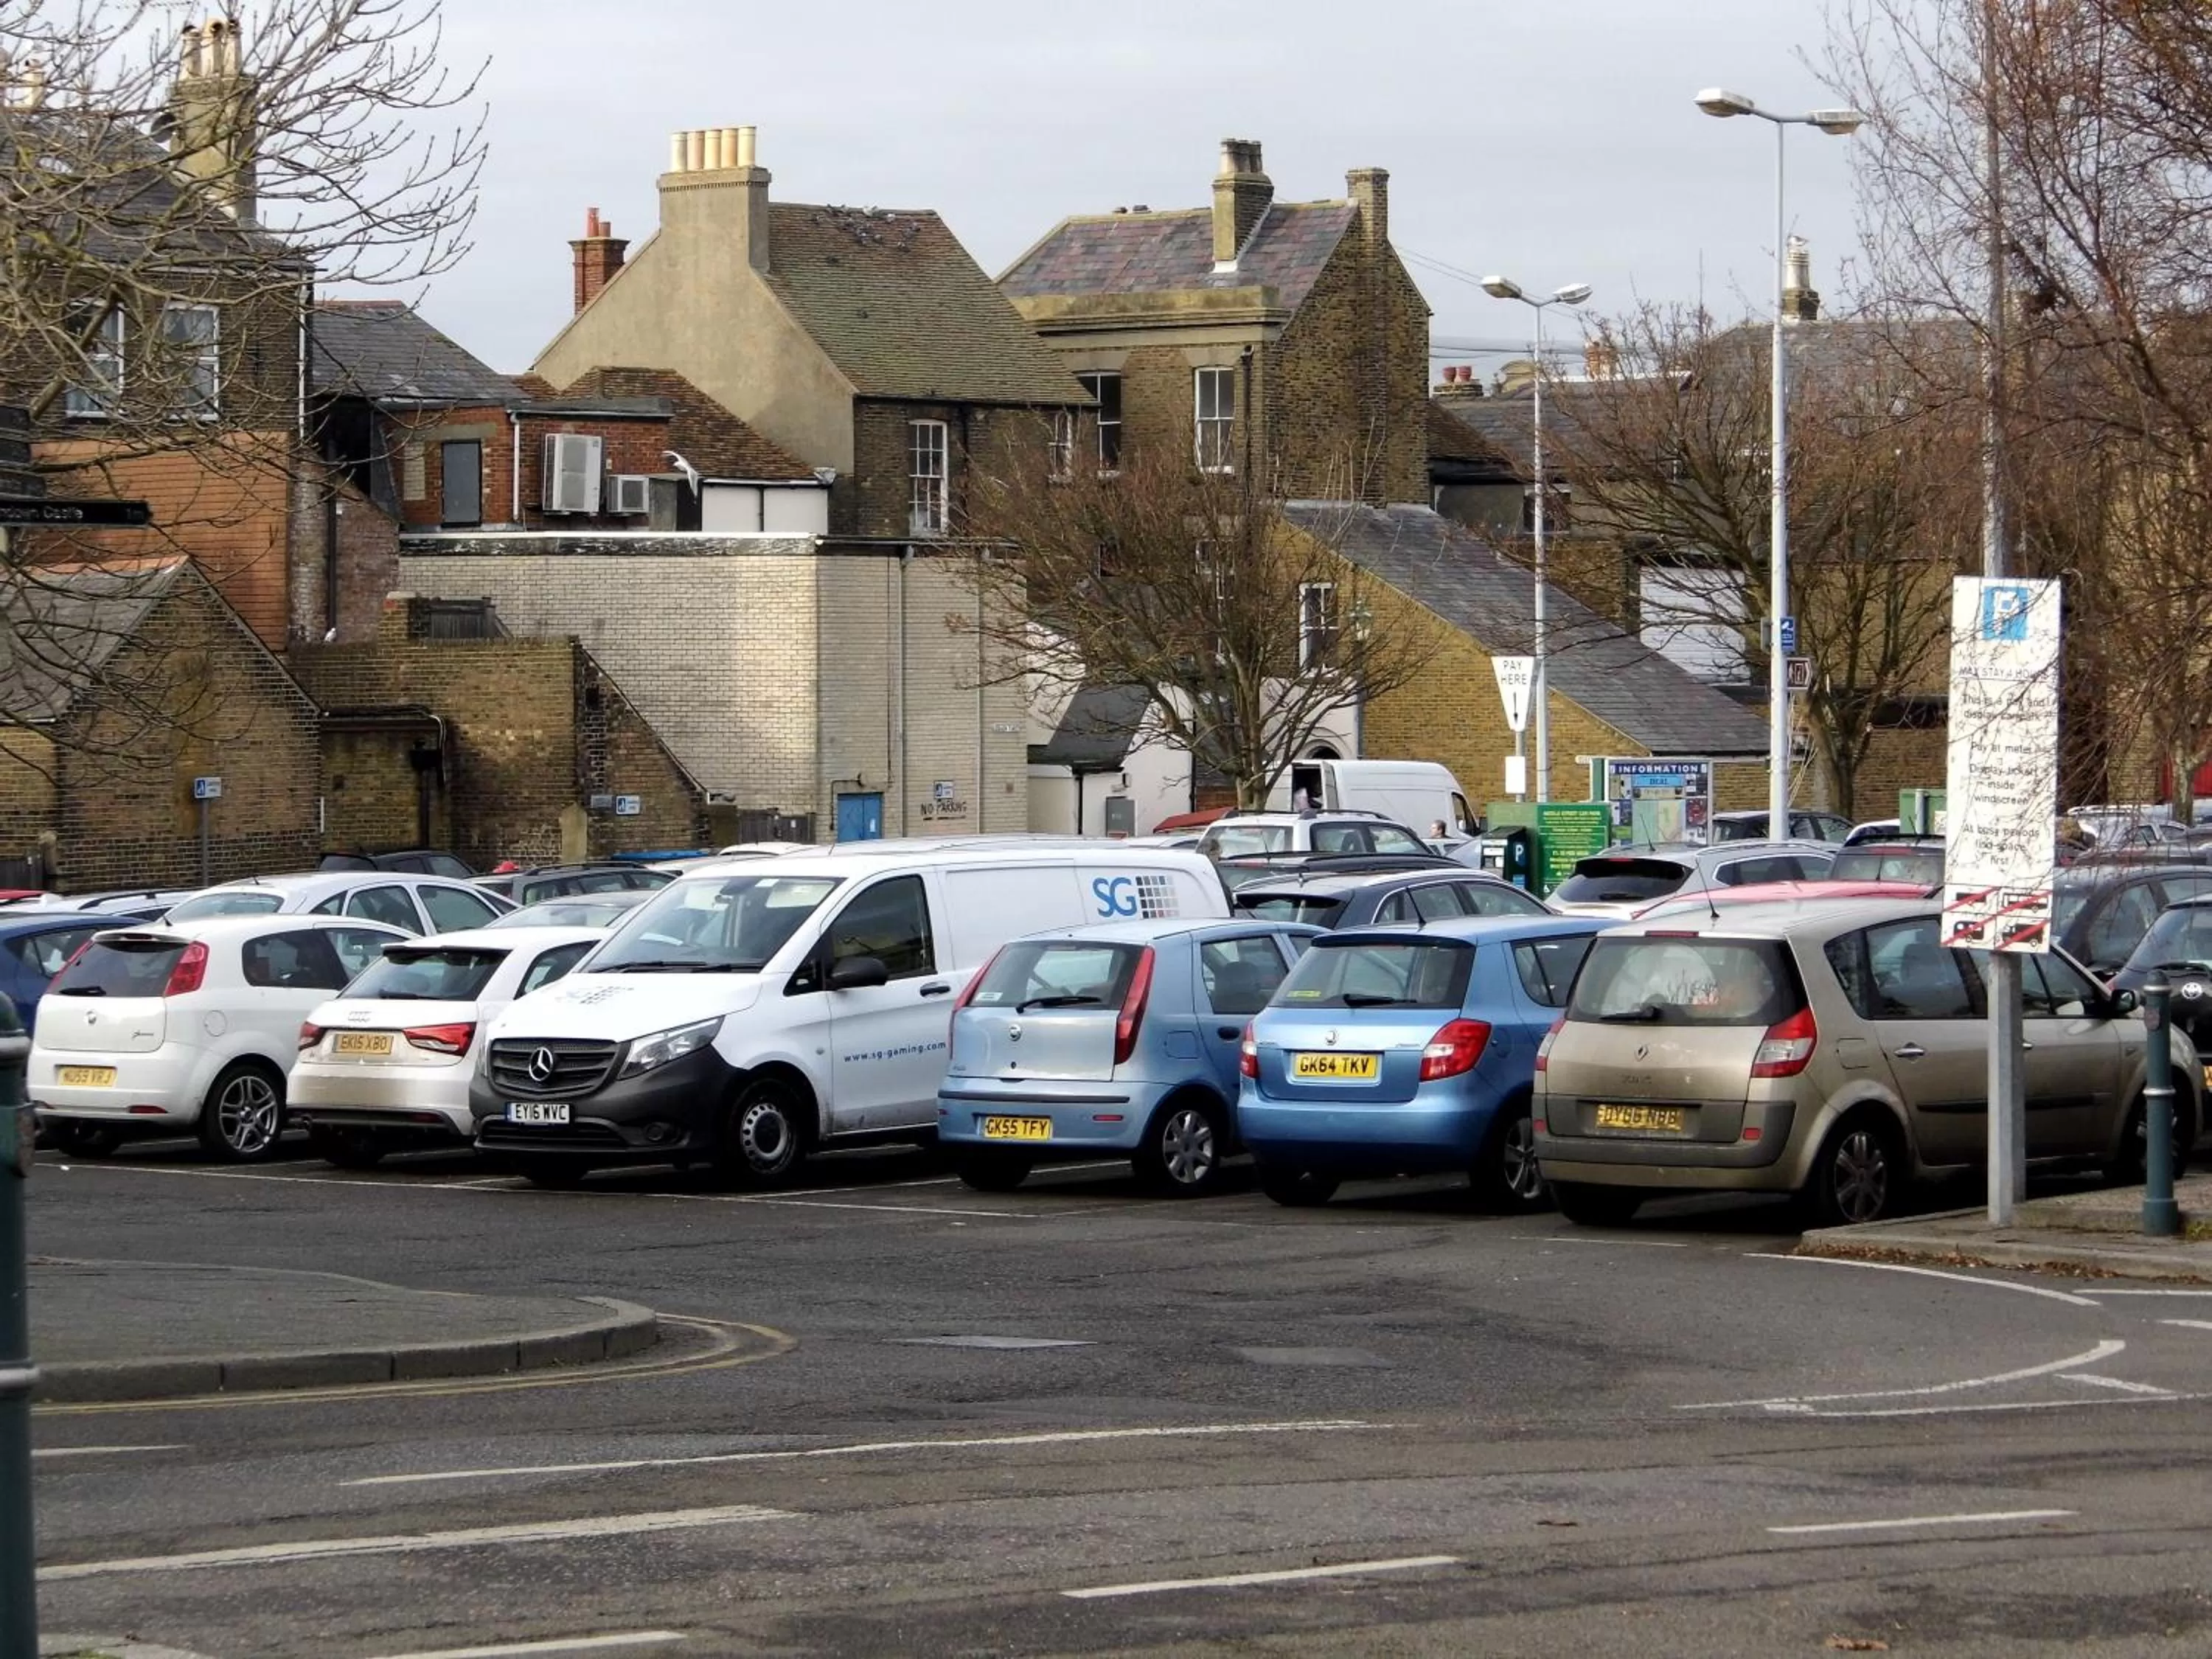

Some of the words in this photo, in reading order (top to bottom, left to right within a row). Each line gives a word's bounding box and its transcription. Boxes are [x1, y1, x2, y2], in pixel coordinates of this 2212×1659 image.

[1994, 591, 2020, 635] P
[1503, 660, 1523, 670] PAY
[1500, 673, 1527, 685] HERE
[1983, 667, 2006, 678] STAY
[1962, 694, 1981, 706] This
[1971, 741, 1987, 754] Pay
[1992, 742, 2000, 753] at
[1618, 765, 1699, 773] INFORMATION
[1987, 779, 2015, 790] inside
[1974, 794, 2029, 805] windscreen
[920, 803, 933, 816] NO
[1515, 844, 1525, 862] P
[1990, 855, 2010, 865] first
[1092, 877, 1138, 918] SG
[341, 1034, 364, 1050] EK15
[843, 1041, 946, 1062] www.sg-gaming.com
[1299, 1054, 1336, 1073] GK64
[1343, 1056, 1370, 1074] TKV
[515, 1103, 540, 1120] EY16
[987, 1119, 1018, 1135] GK55
[1021, 1120, 1048, 1136] TFY
